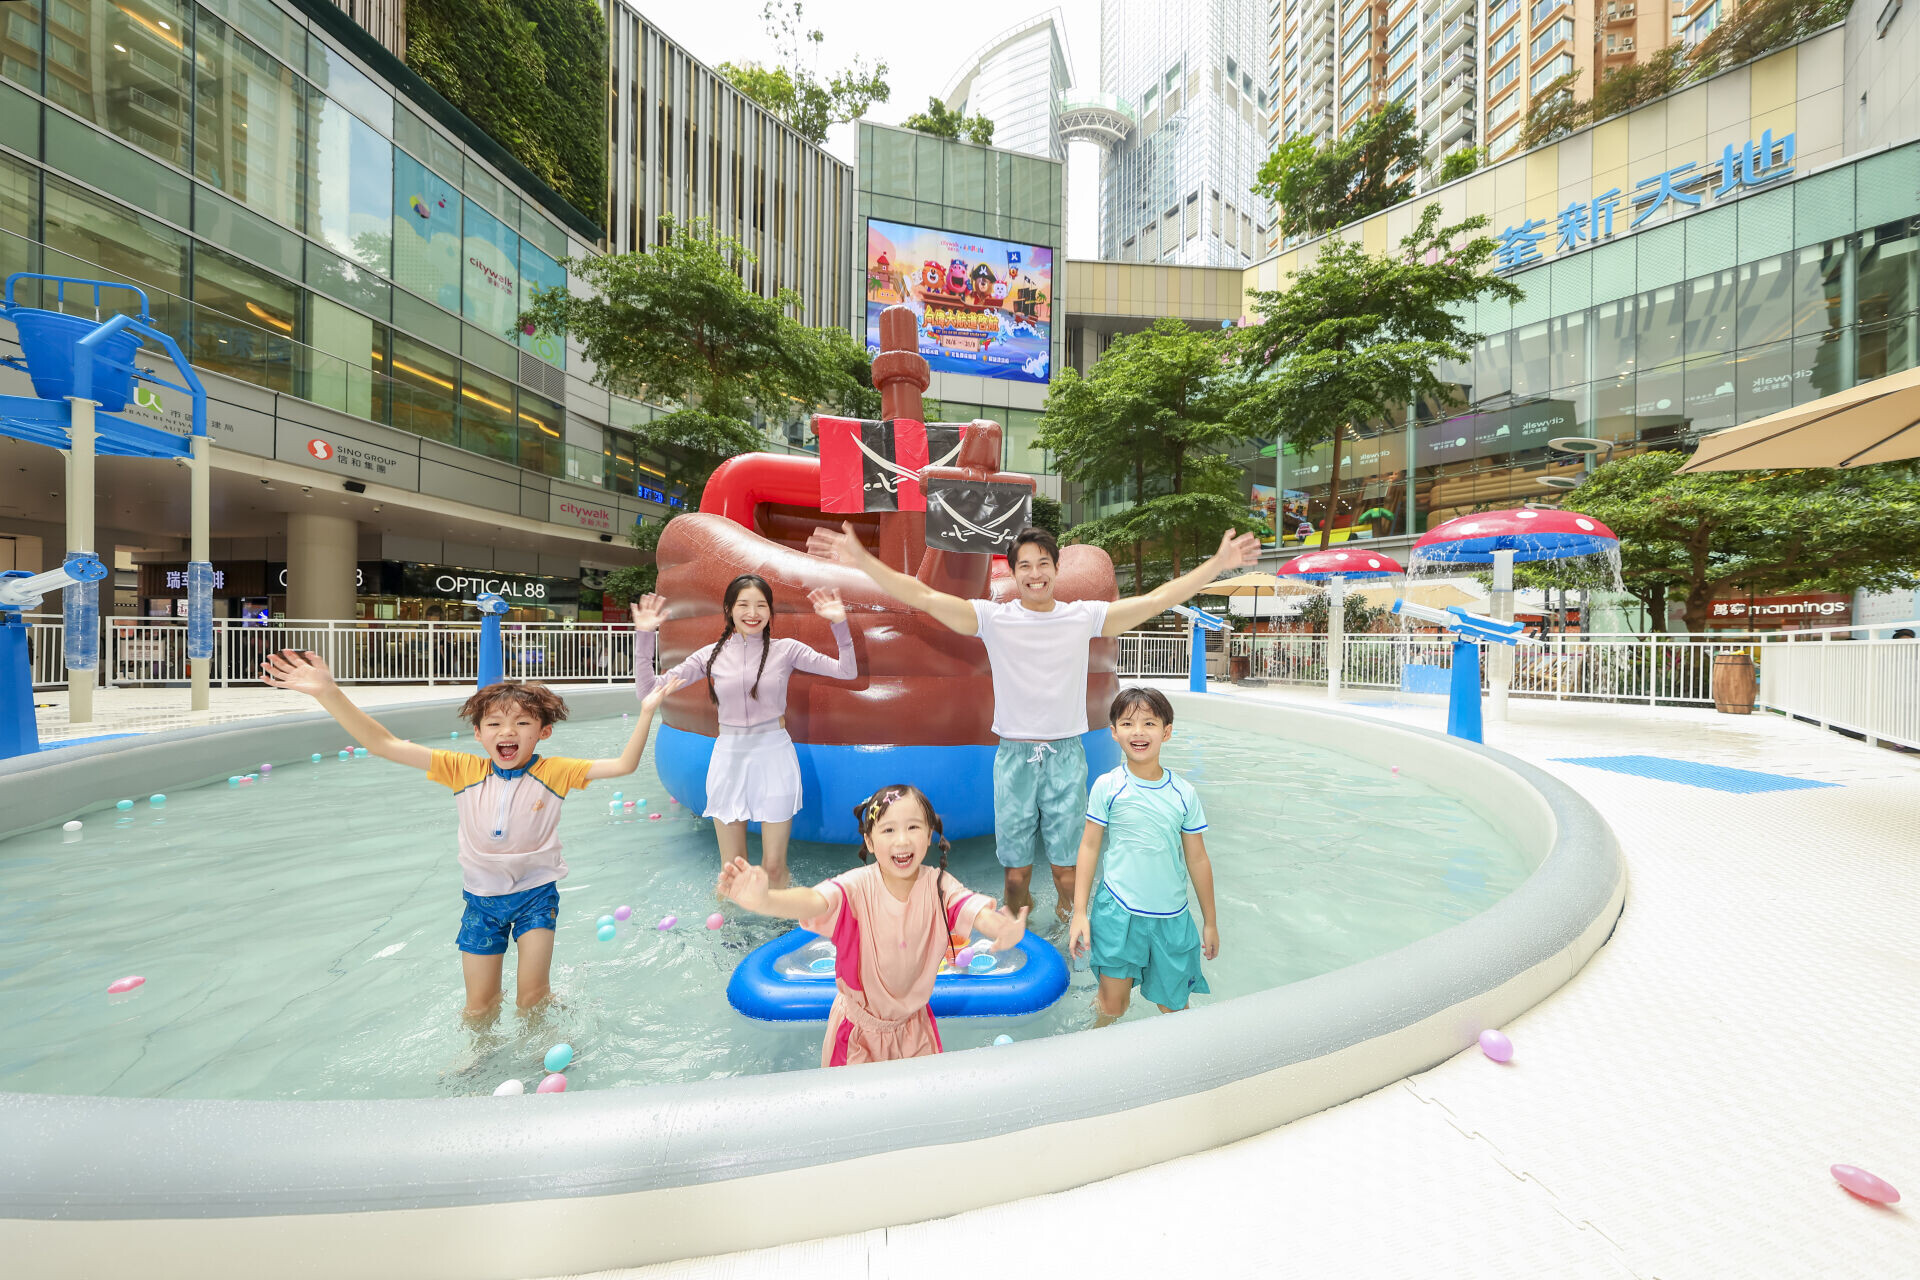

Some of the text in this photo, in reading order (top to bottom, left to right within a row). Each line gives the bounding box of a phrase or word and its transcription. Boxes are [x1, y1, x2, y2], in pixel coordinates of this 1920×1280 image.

[1491, 128, 1796, 273] 荃新天地
[469, 257, 513, 289] citywalk
[153, 414, 192, 429] RENEWA
[170, 410, 234, 432] 市區建局
[337, 446, 397, 466] SINO GROUP
[337, 454, 386, 474] 信和集團
[560, 502, 609, 520] citywalk
[435, 575, 546, 599] OPTICAL 88
[1748, 600, 1846, 615] mannings
